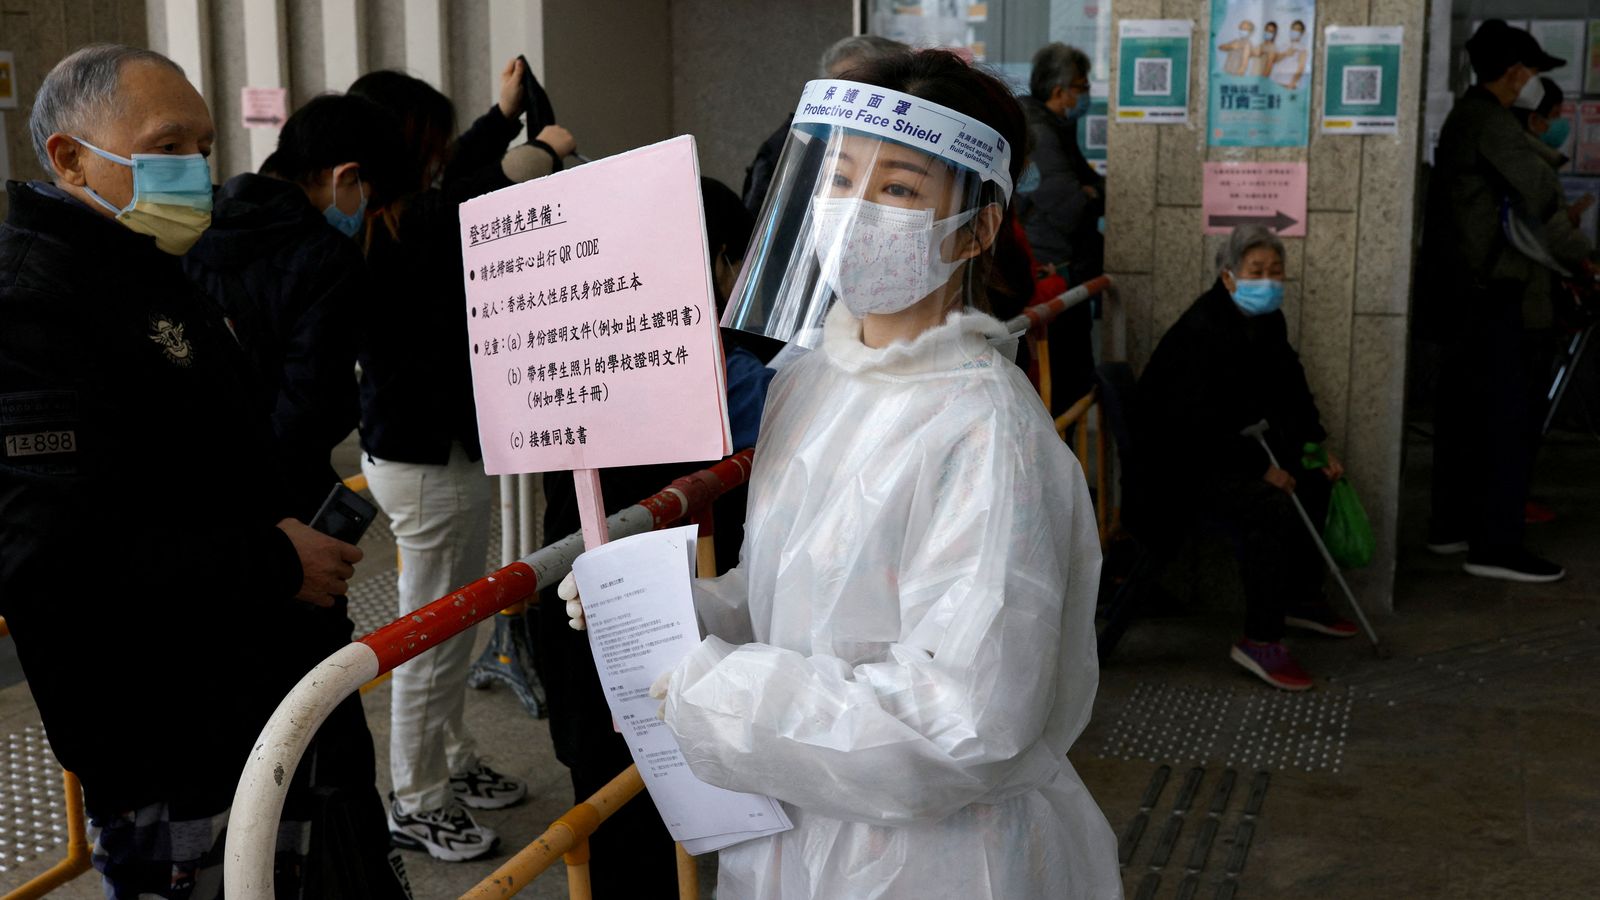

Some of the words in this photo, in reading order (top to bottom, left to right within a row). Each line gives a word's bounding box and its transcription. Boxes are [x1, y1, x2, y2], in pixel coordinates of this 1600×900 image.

[823, 86, 912, 116] 保護面罩
[803, 103, 853, 119] Protective
[855, 109, 890, 127] Face
[893, 119, 942, 145] Shield
[949, 145, 965, 155] fluid
[964, 151, 990, 168] splashing
[953, 138, 975, 152] Protect
[975, 149, 994, 162] against
[559, 244, 571, 264] QR
[576, 238, 599, 259] CODE
[507, 367, 522, 386] (b)
[527, 345, 689, 383] 帶有學生照片的學校證明文件
[527, 382, 609, 410] (例如學生手冊)
[510, 431, 524, 449] (c)
[528, 425, 588, 448] 接種同意書
